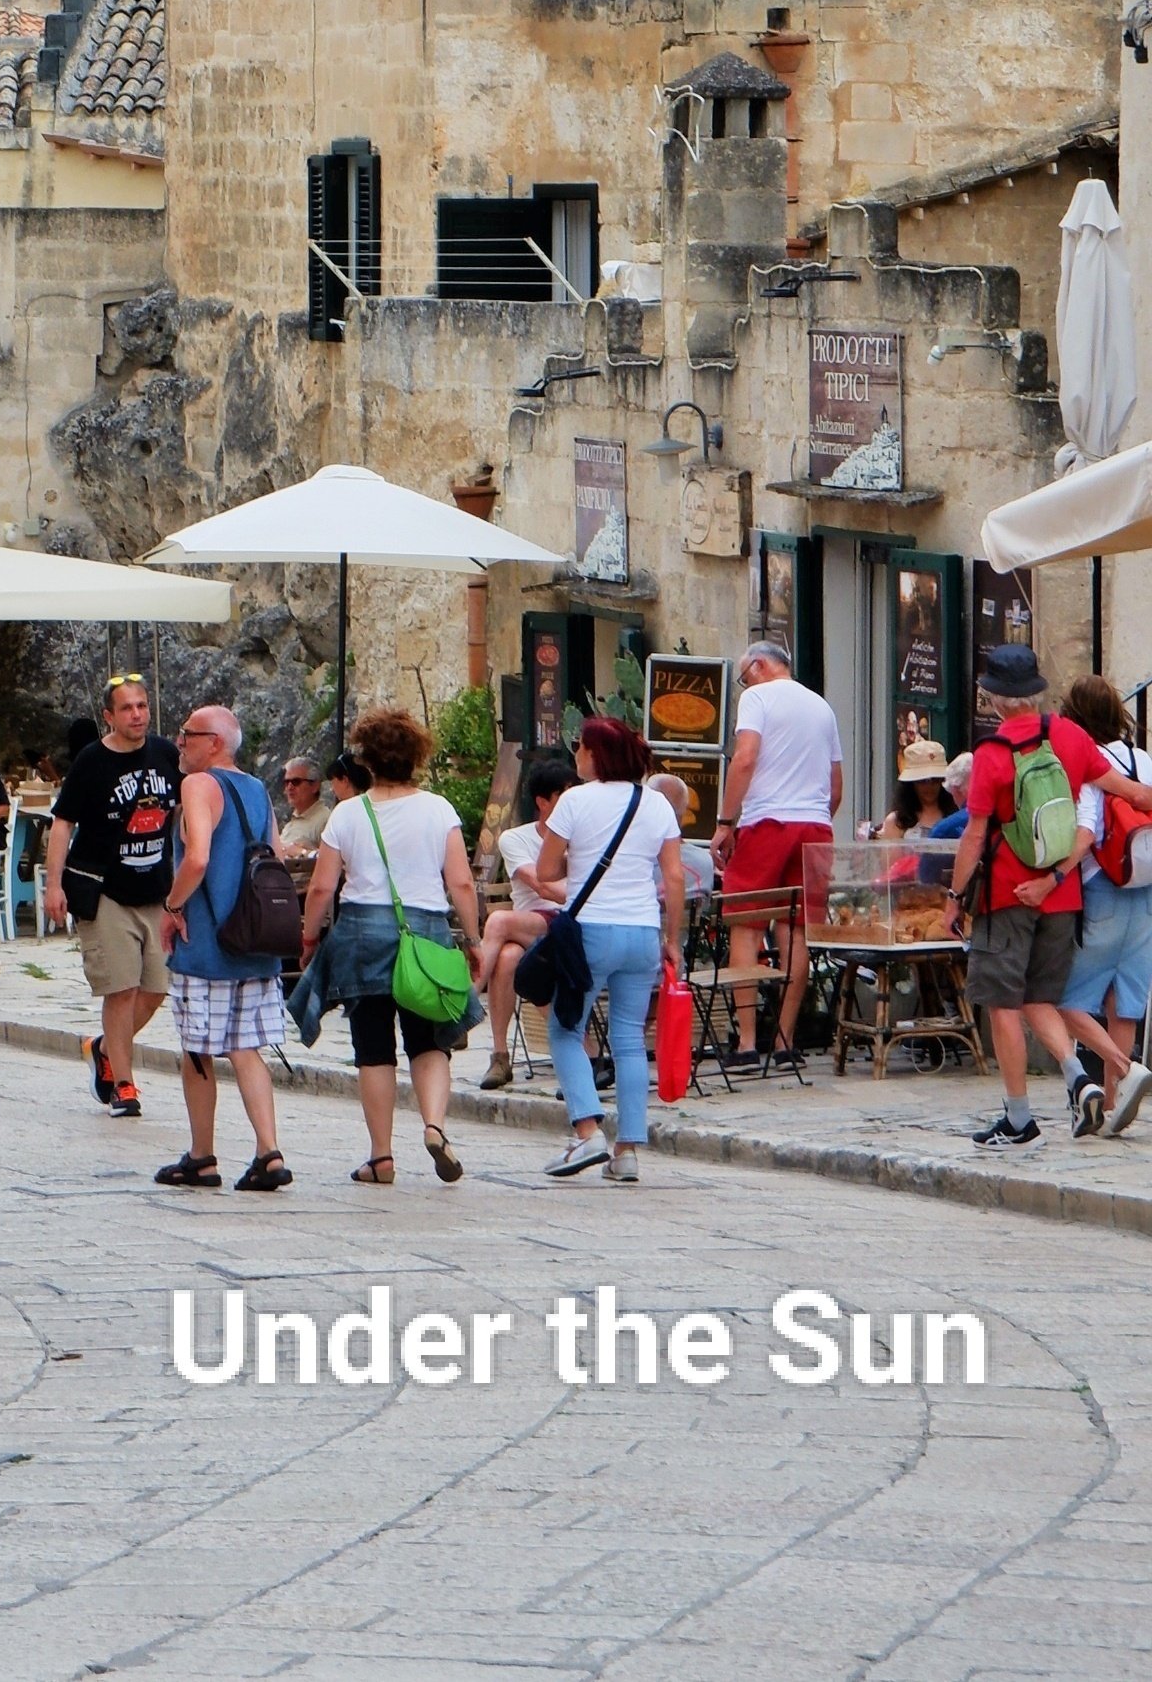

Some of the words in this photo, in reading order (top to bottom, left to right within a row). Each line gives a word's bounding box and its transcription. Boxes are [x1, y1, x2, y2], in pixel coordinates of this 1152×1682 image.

[812, 334, 891, 366] PRODOTTI
[824, 371, 870, 402] TIPICI
[576, 485, 610, 511] PANIFICIO
[653, 670, 716, 695] PIZZA
[119, 843, 129, 855] IN
[131, 842, 144, 854] MY
